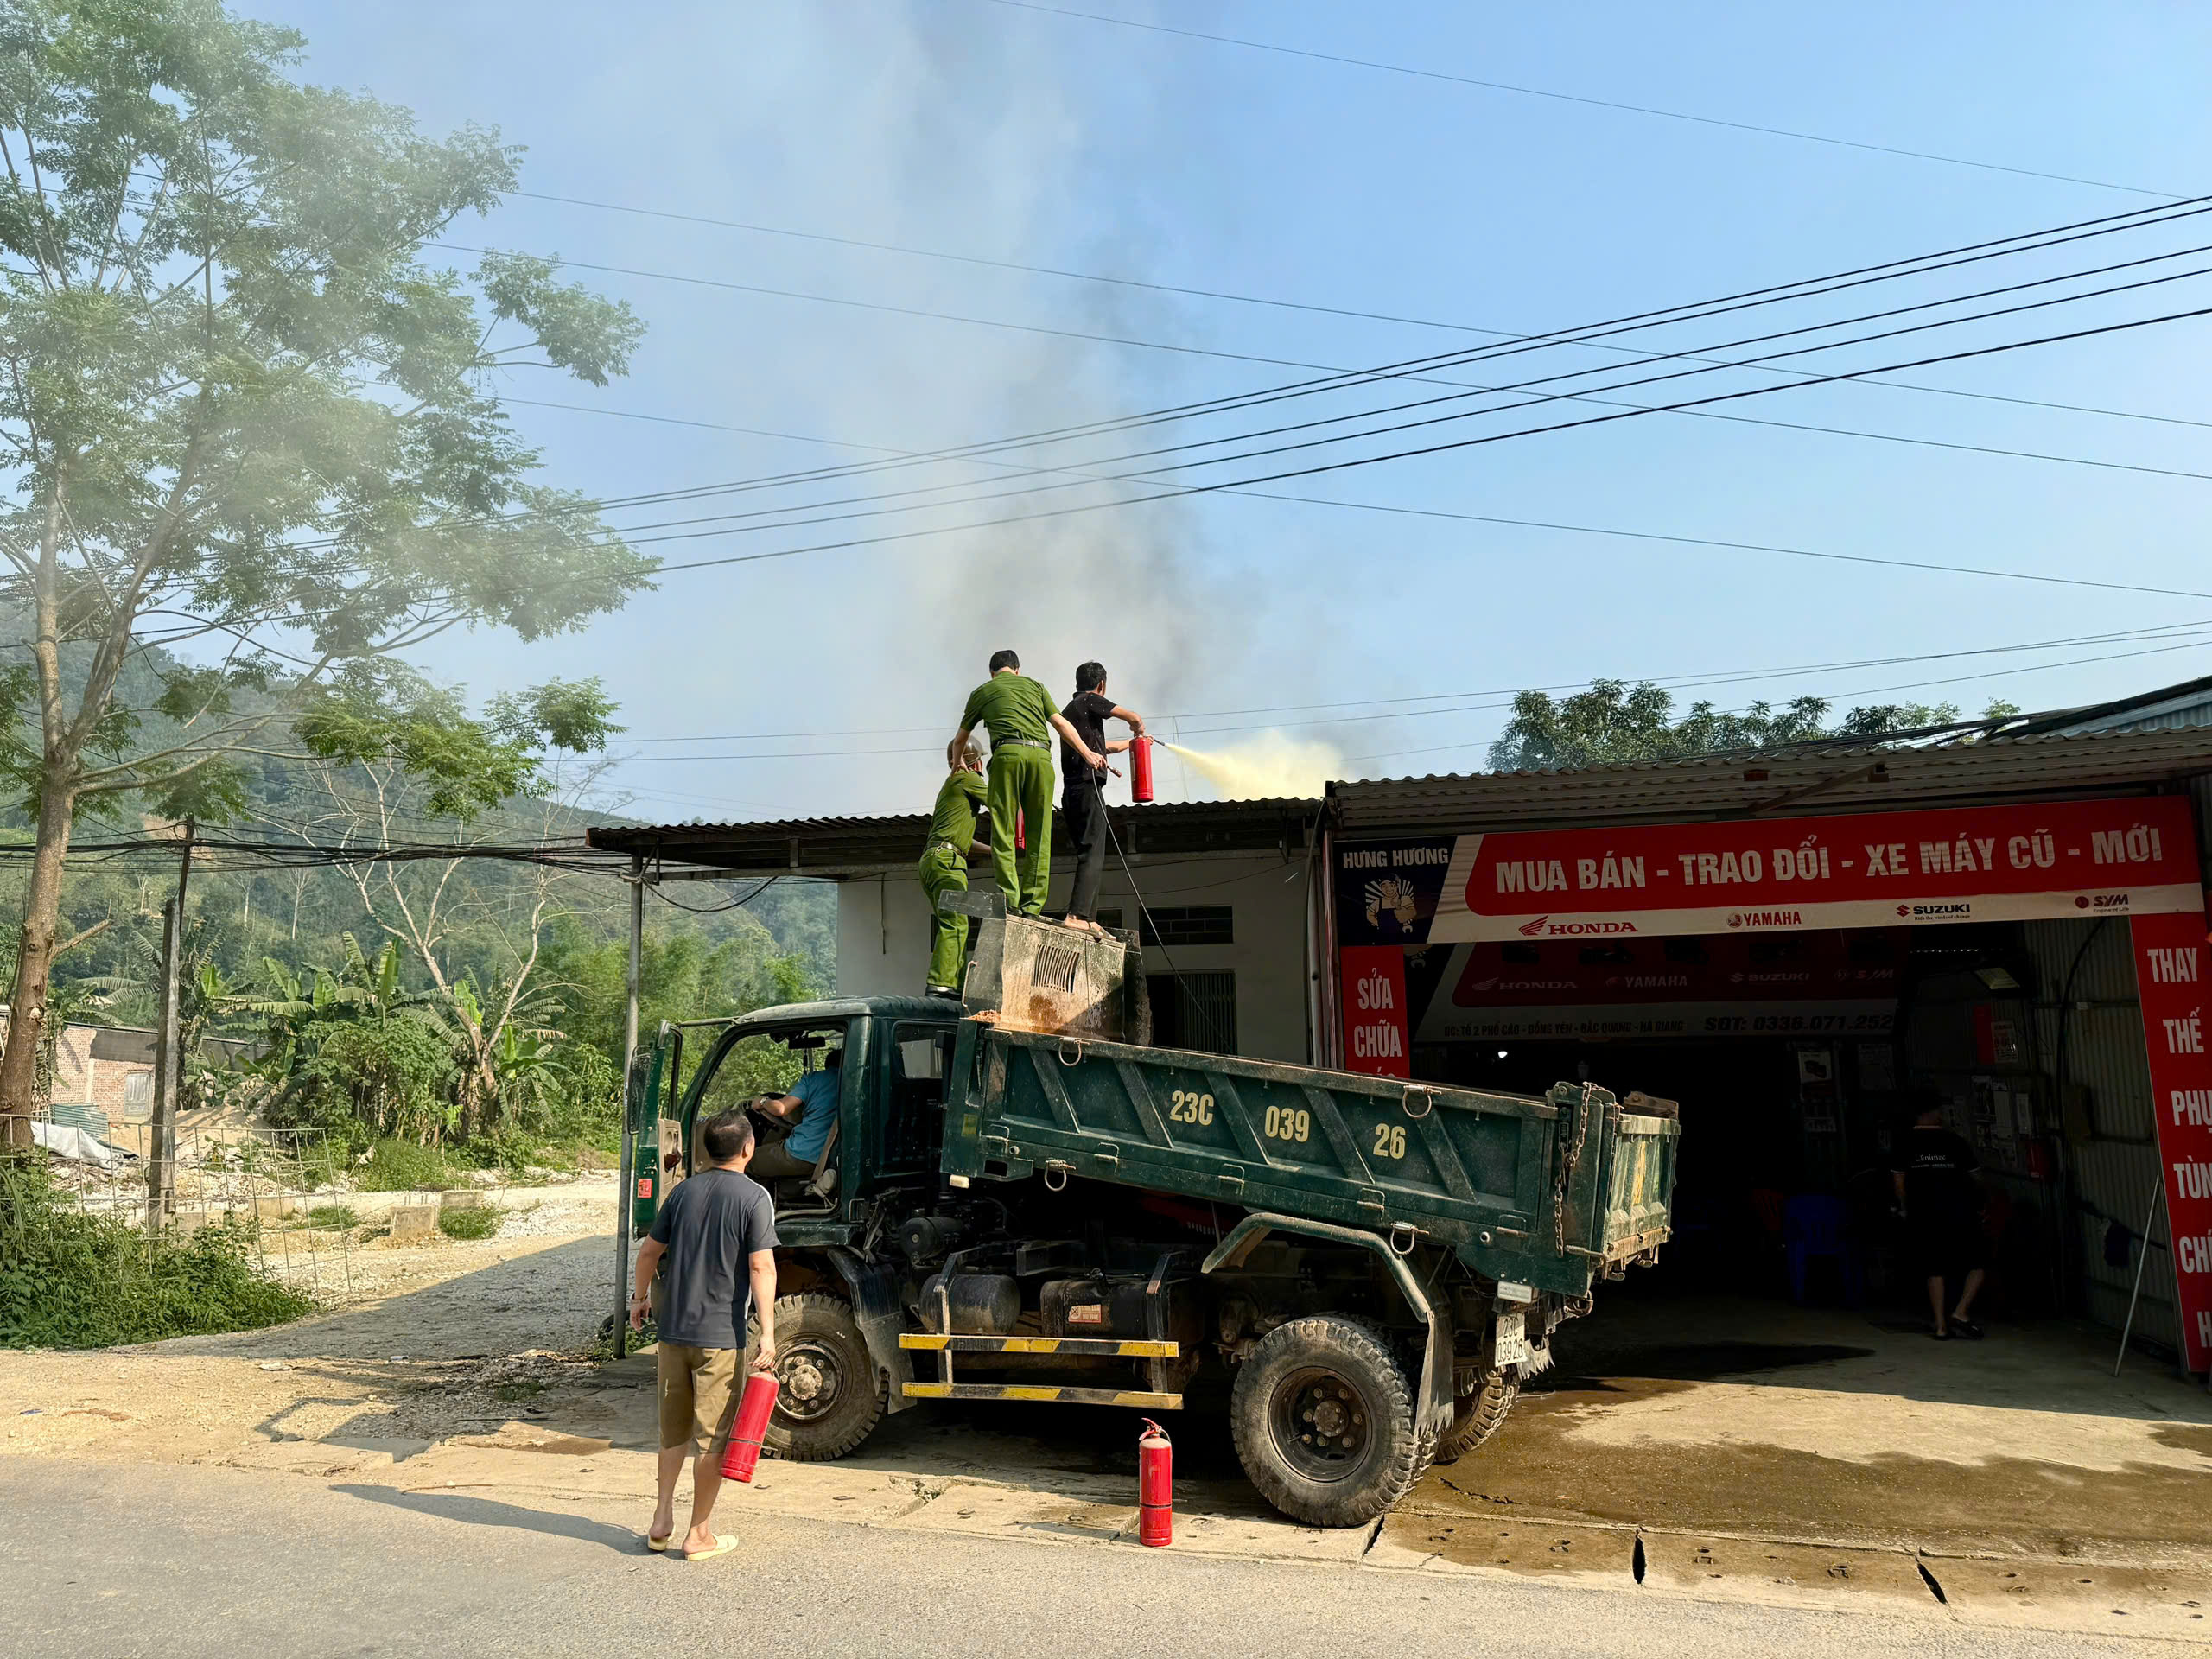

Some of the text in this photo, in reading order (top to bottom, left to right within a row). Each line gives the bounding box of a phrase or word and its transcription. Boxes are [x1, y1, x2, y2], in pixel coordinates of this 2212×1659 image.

[1343, 847, 1449, 868] HƯNG HƯƠNG
[1496, 859, 1568, 893] MUA
[1577, 850, 1646, 890] BÁN
[1678, 849, 1763, 886] TRAO
[1772, 834, 1831, 881] ĐỔI
[1864, 842, 1909, 877] XE
[1918, 832, 1995, 874] MÁY
[2007, 828, 2056, 869] CŨ
[2091, 823, 2163, 865] MỚI
[1913, 904, 1970, 914] SUZUKI
[2094, 894, 2129, 906] SYM
[1548, 921, 1639, 935] HONDA
[1744, 911, 1802, 927] YAMAHA
[2147, 947, 2198, 983] THAY
[1498, 981, 1579, 990] HONDA
[1625, 976, 1688, 988] YAMAHA
[1748, 972, 1810, 982] SUZUKI
[1357, 967, 1394, 1010] SỬA
[1354, 1019, 1402, 1058] CHỮA
[2163, 1007, 2205, 1054] THẾ
[1169, 1090, 1407, 1160] 23C 039 26
[1503, 1316, 1519, 1338] 23C
